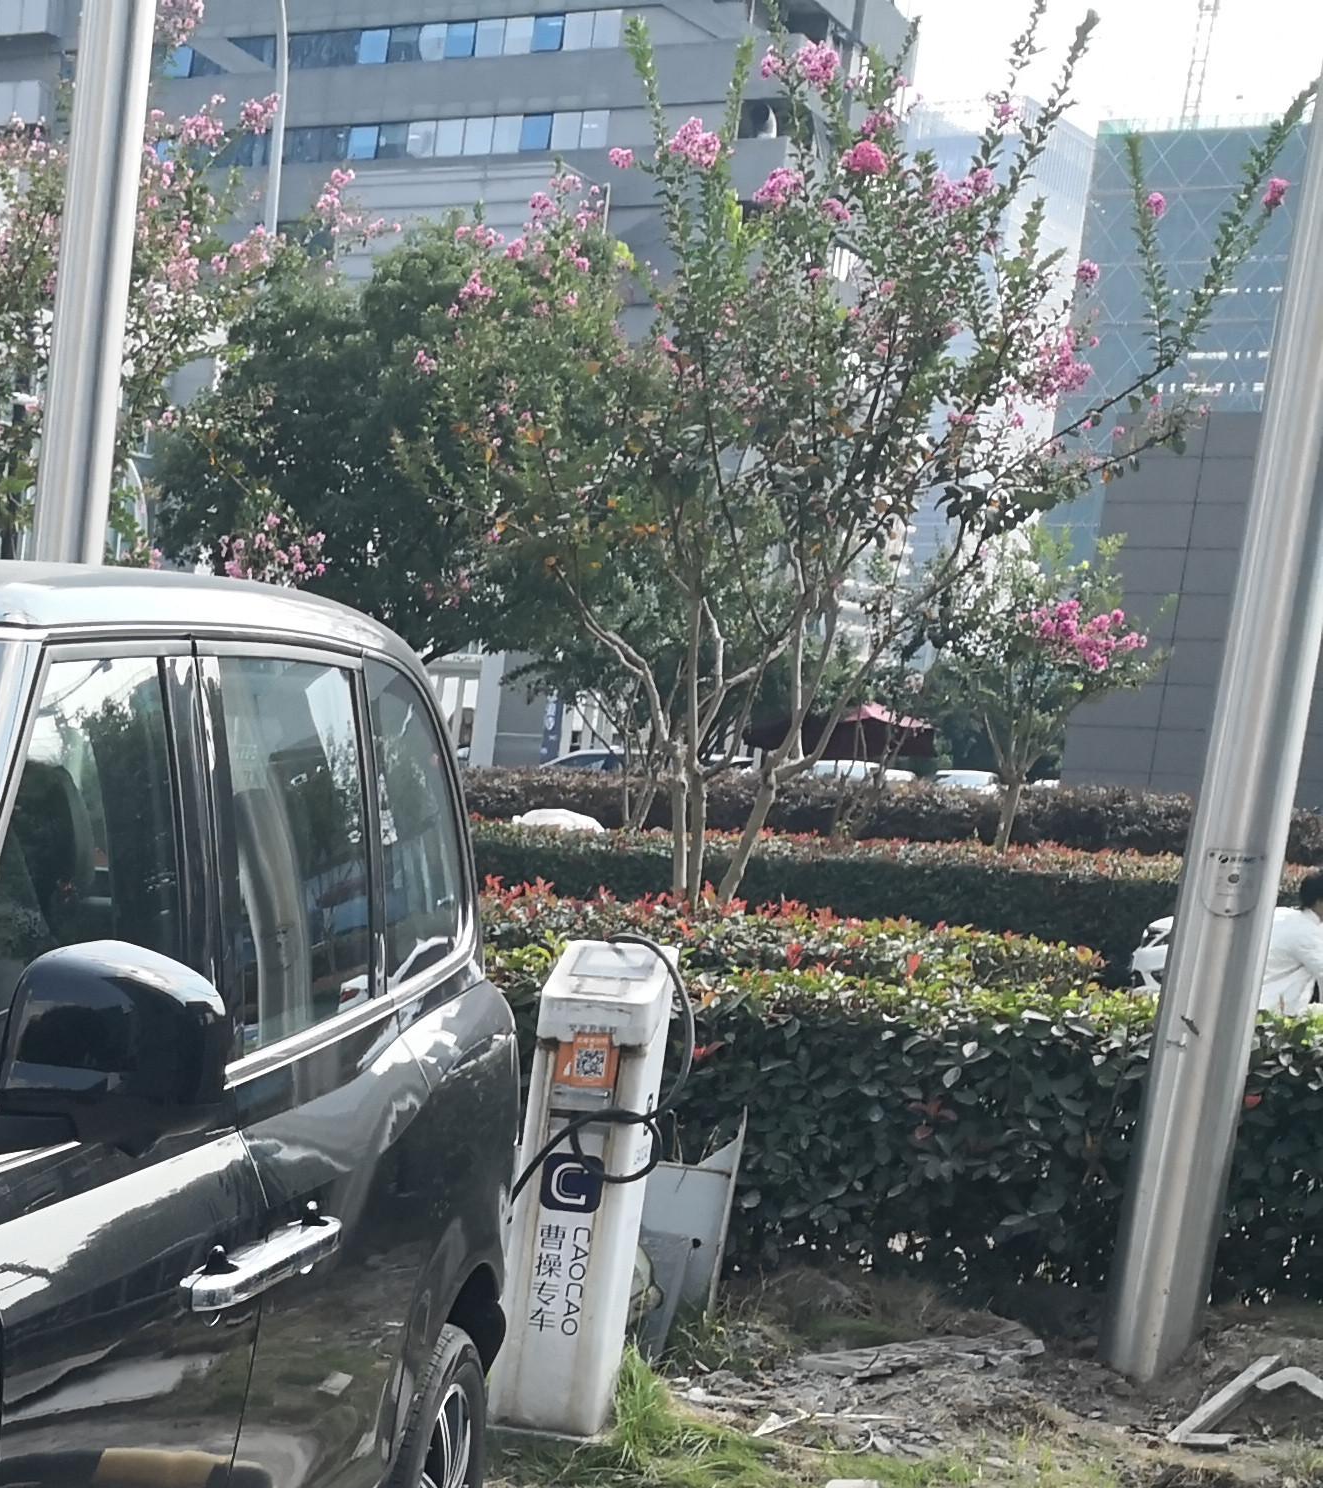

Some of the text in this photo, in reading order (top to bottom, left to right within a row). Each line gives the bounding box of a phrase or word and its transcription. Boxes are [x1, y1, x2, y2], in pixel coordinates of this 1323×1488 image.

[528, 1223, 568, 1333] 曹操专车
[560, 1226, 592, 1337] CAOCAO
